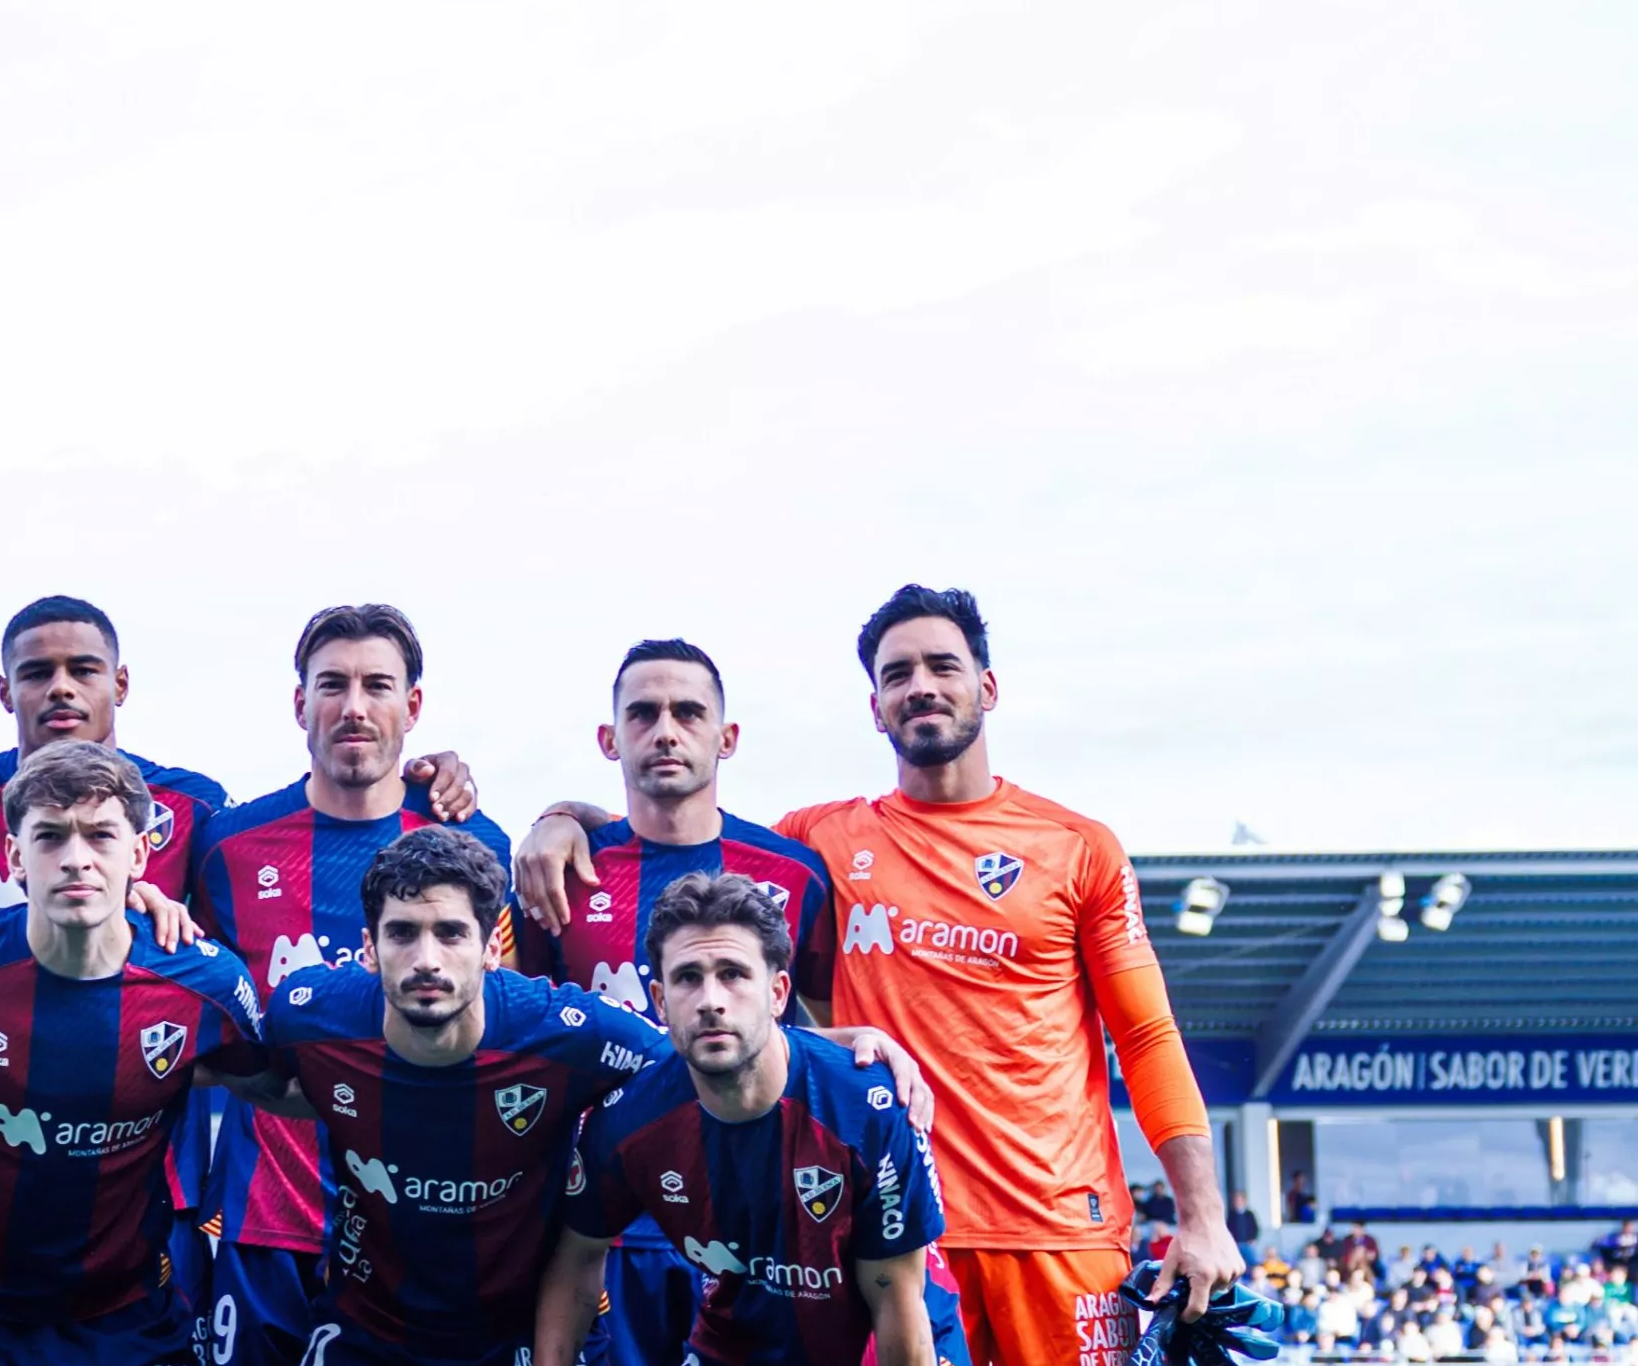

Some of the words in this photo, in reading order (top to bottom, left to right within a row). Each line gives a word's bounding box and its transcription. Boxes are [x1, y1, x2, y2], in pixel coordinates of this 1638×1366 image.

[899, 917, 1018, 958] aramon
[1292, 1043, 1414, 1091] ARAGÓN
[1430, 1051, 1525, 1089] SABOR
[1530, 1051, 1568, 1089] DE
[55, 1108, 164, 1145] aramon
[748, 1256, 843, 1289] ramon
[213, 1294, 237, 1366] 9
